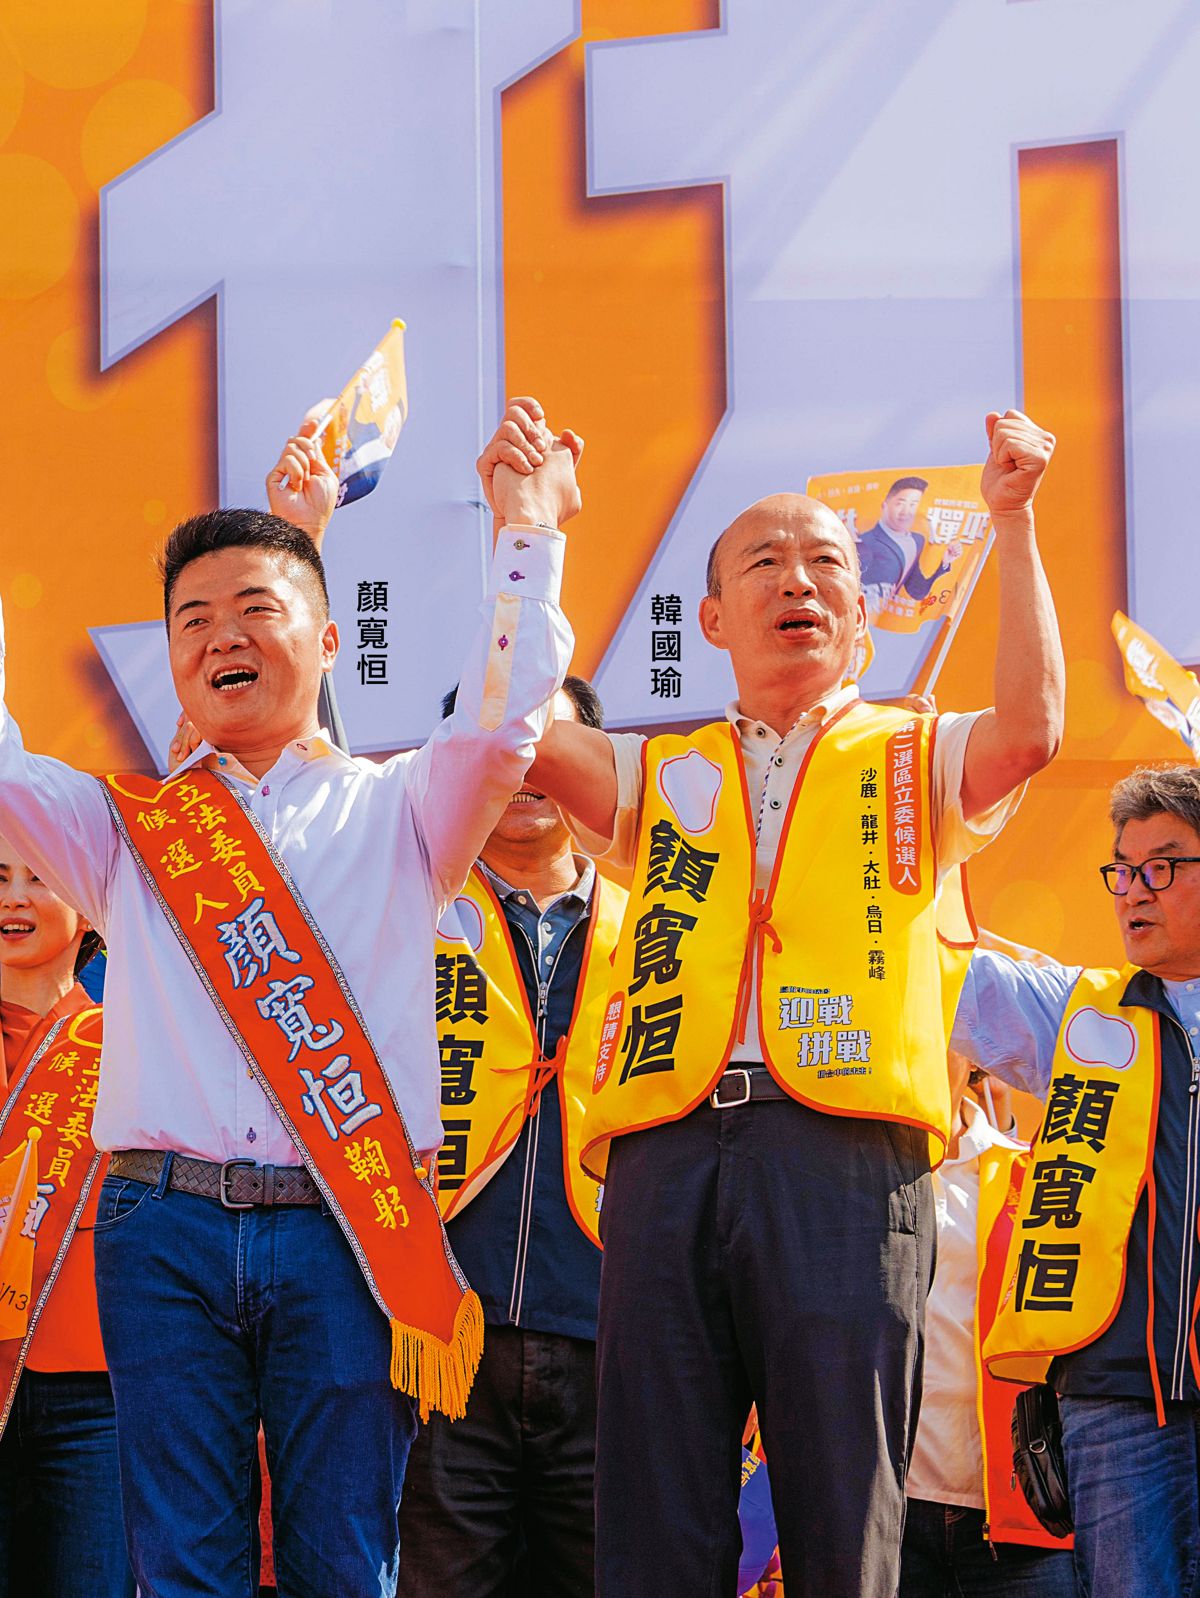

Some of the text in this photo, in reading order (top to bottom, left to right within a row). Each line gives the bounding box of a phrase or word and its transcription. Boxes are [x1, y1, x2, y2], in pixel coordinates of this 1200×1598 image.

[177, 783, 266, 904] 立法委員
[893, 719, 918, 887] 第二選區立委候選人
[136, 806, 230, 926] 候選人
[619, 819, 720, 1087] 顏寬恒
[778, 994, 853, 1031] 迎戰
[216, 897, 383, 1142] 顏寬恒
[797, 1030, 872, 1068] 拼戰
[344, 1136, 410, 1231] 鞠躬
[1013, 1072, 1120, 1314] 顏寬恒
